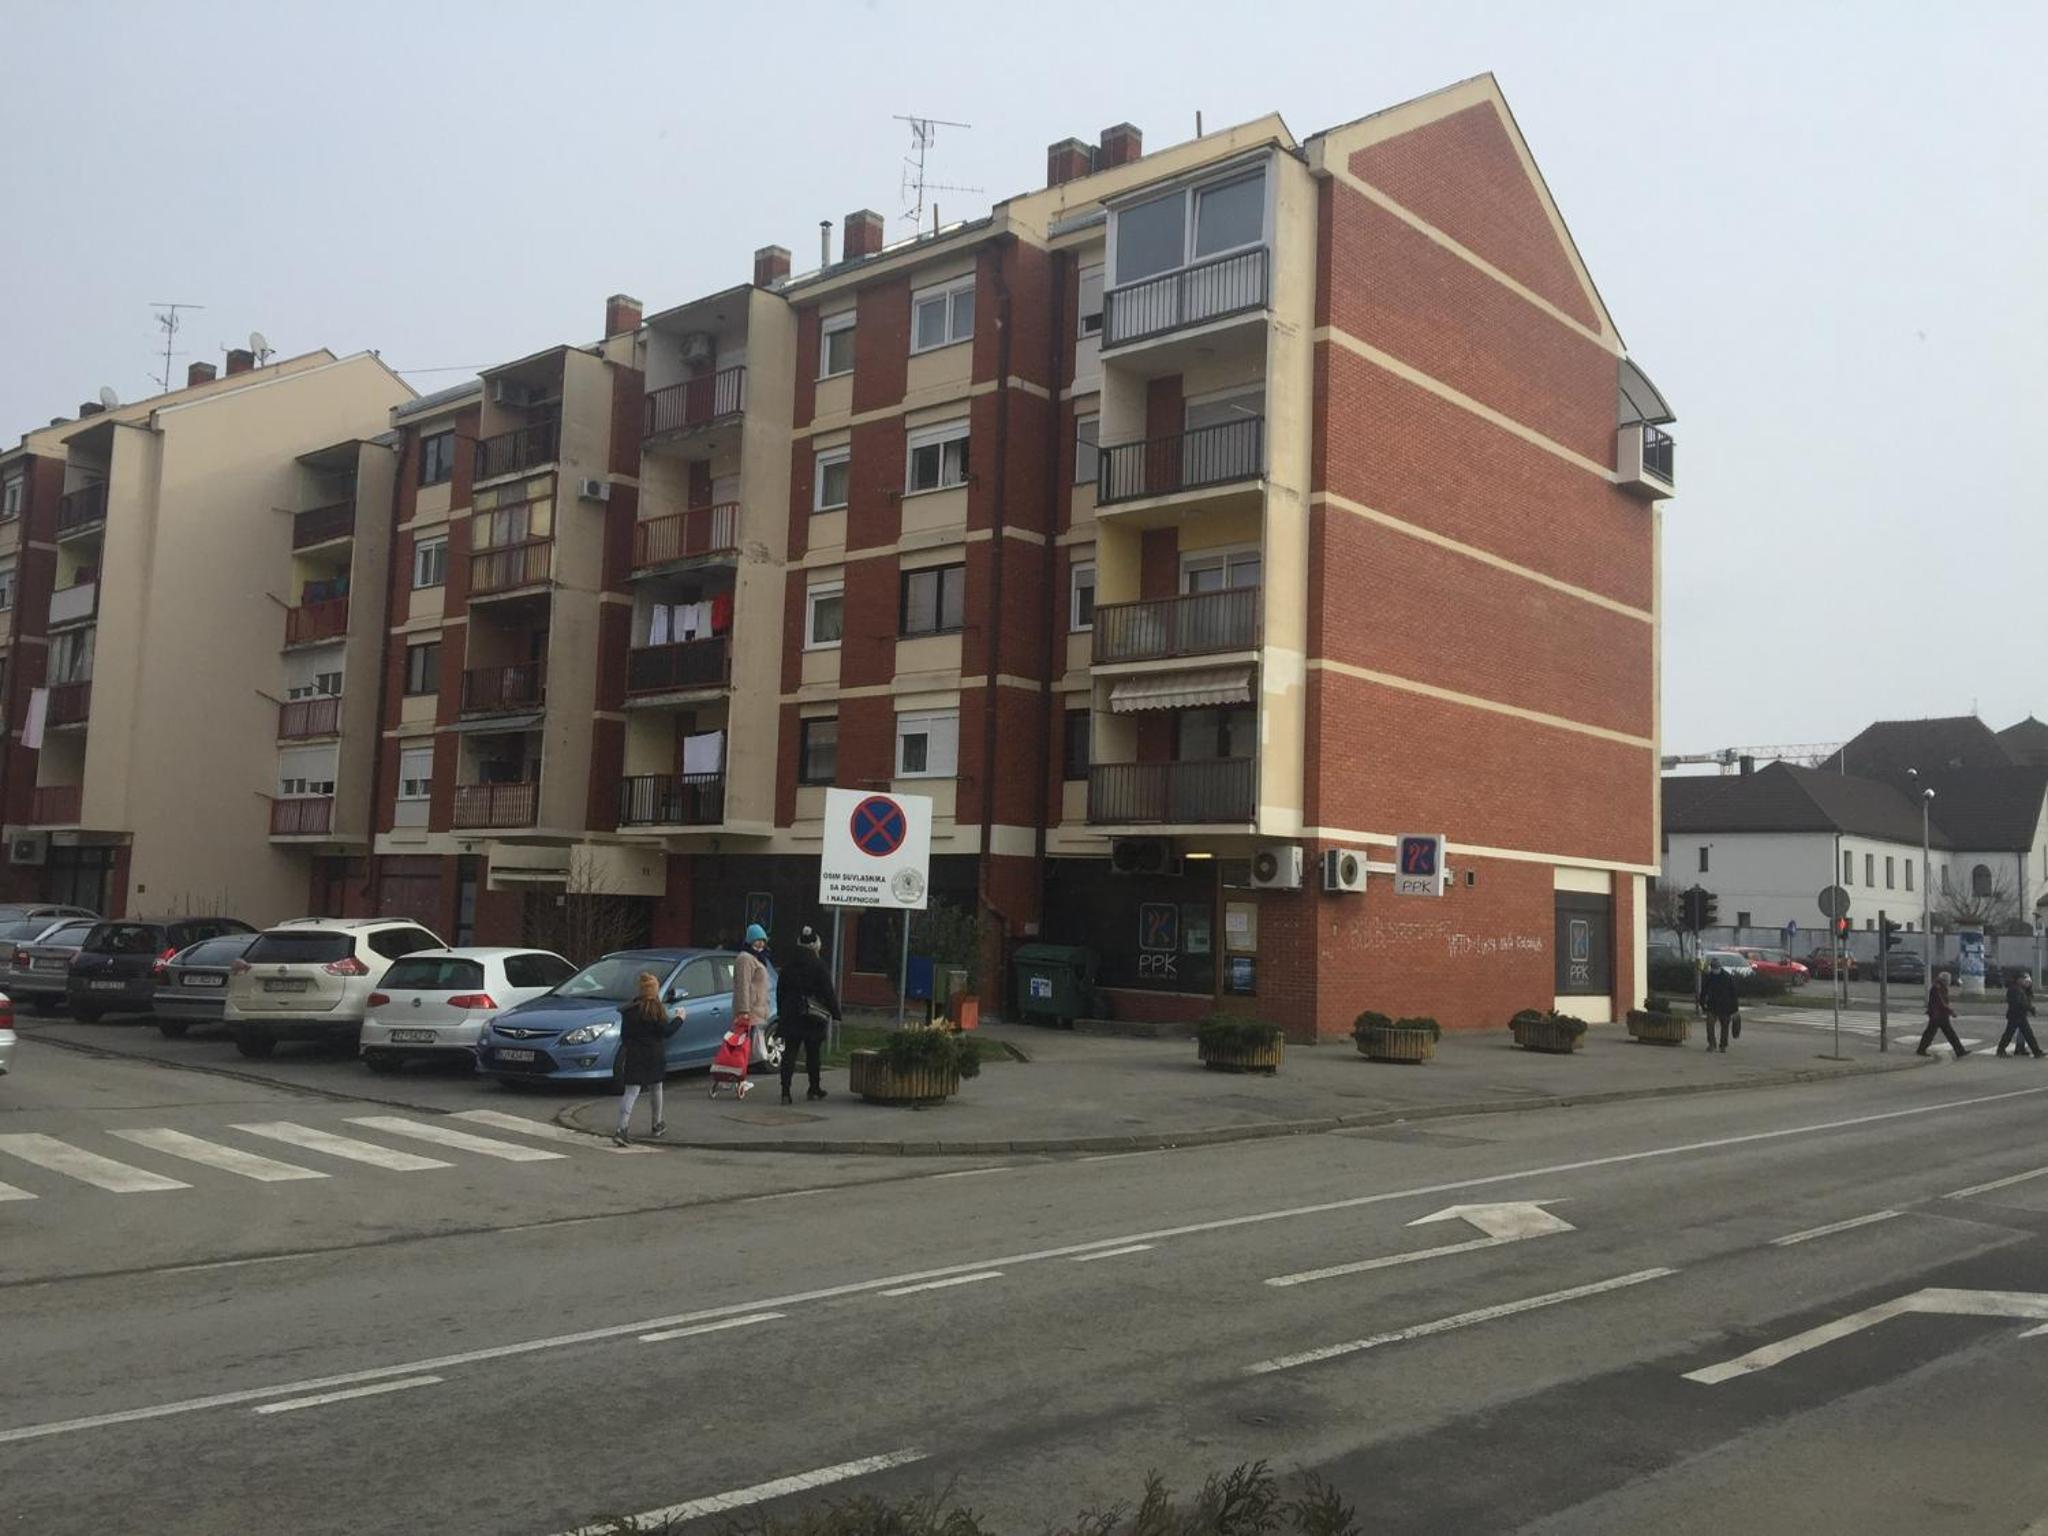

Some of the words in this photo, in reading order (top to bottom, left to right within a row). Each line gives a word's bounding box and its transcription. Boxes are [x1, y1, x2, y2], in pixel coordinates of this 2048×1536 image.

[823, 872, 841, 880] OSIM
[843, 873, 886, 883] SUVLASNIKA
[841, 884, 879, 892] DOZVOLOM
[1402, 880, 1431, 894] PPK
[831, 896, 880, 904] NALJEPNICOM
[1138, 953, 1177, 973] PPK
[1569, 964, 1590, 981] PPK
